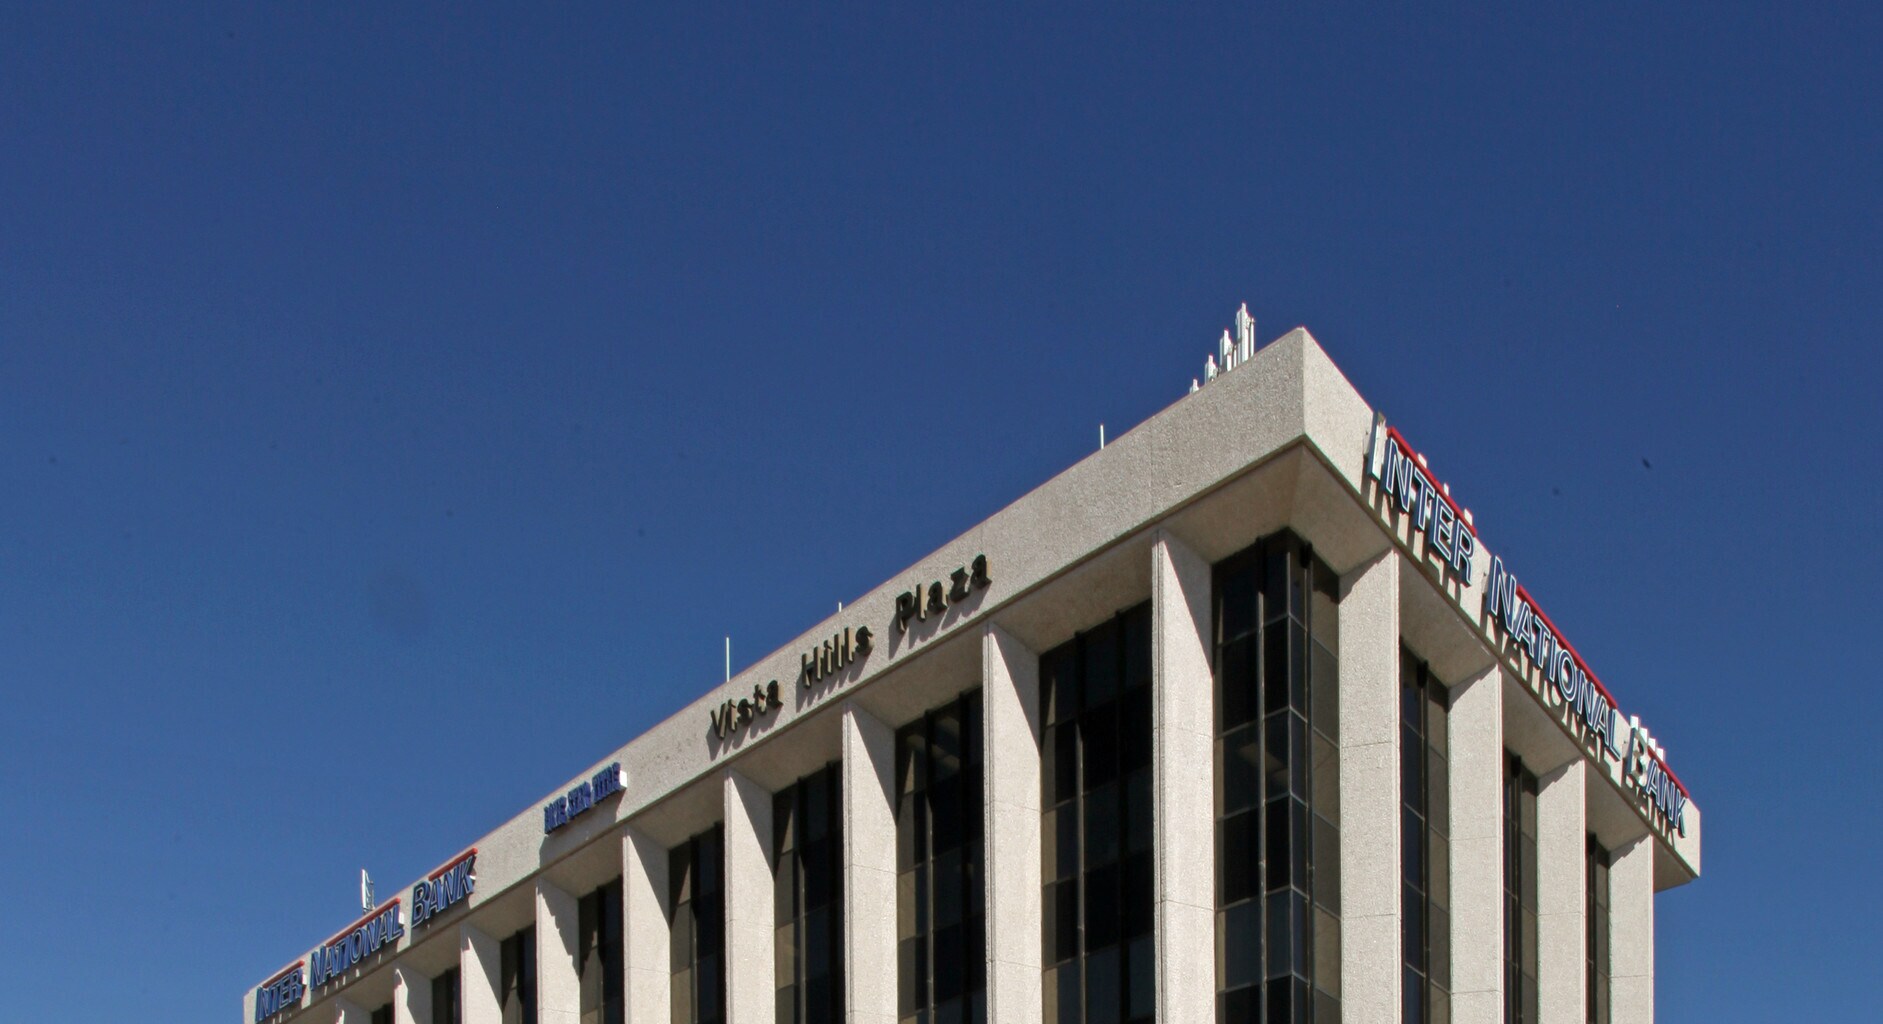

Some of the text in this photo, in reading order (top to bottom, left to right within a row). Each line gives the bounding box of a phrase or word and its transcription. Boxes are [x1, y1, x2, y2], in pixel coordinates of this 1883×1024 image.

[710, 554, 992, 739] Vista Hills Plaza
[1367, 411, 1686, 838] INTER NATIONAL BANK
[256, 854, 475, 1024] INTER NATIONAL BANK
